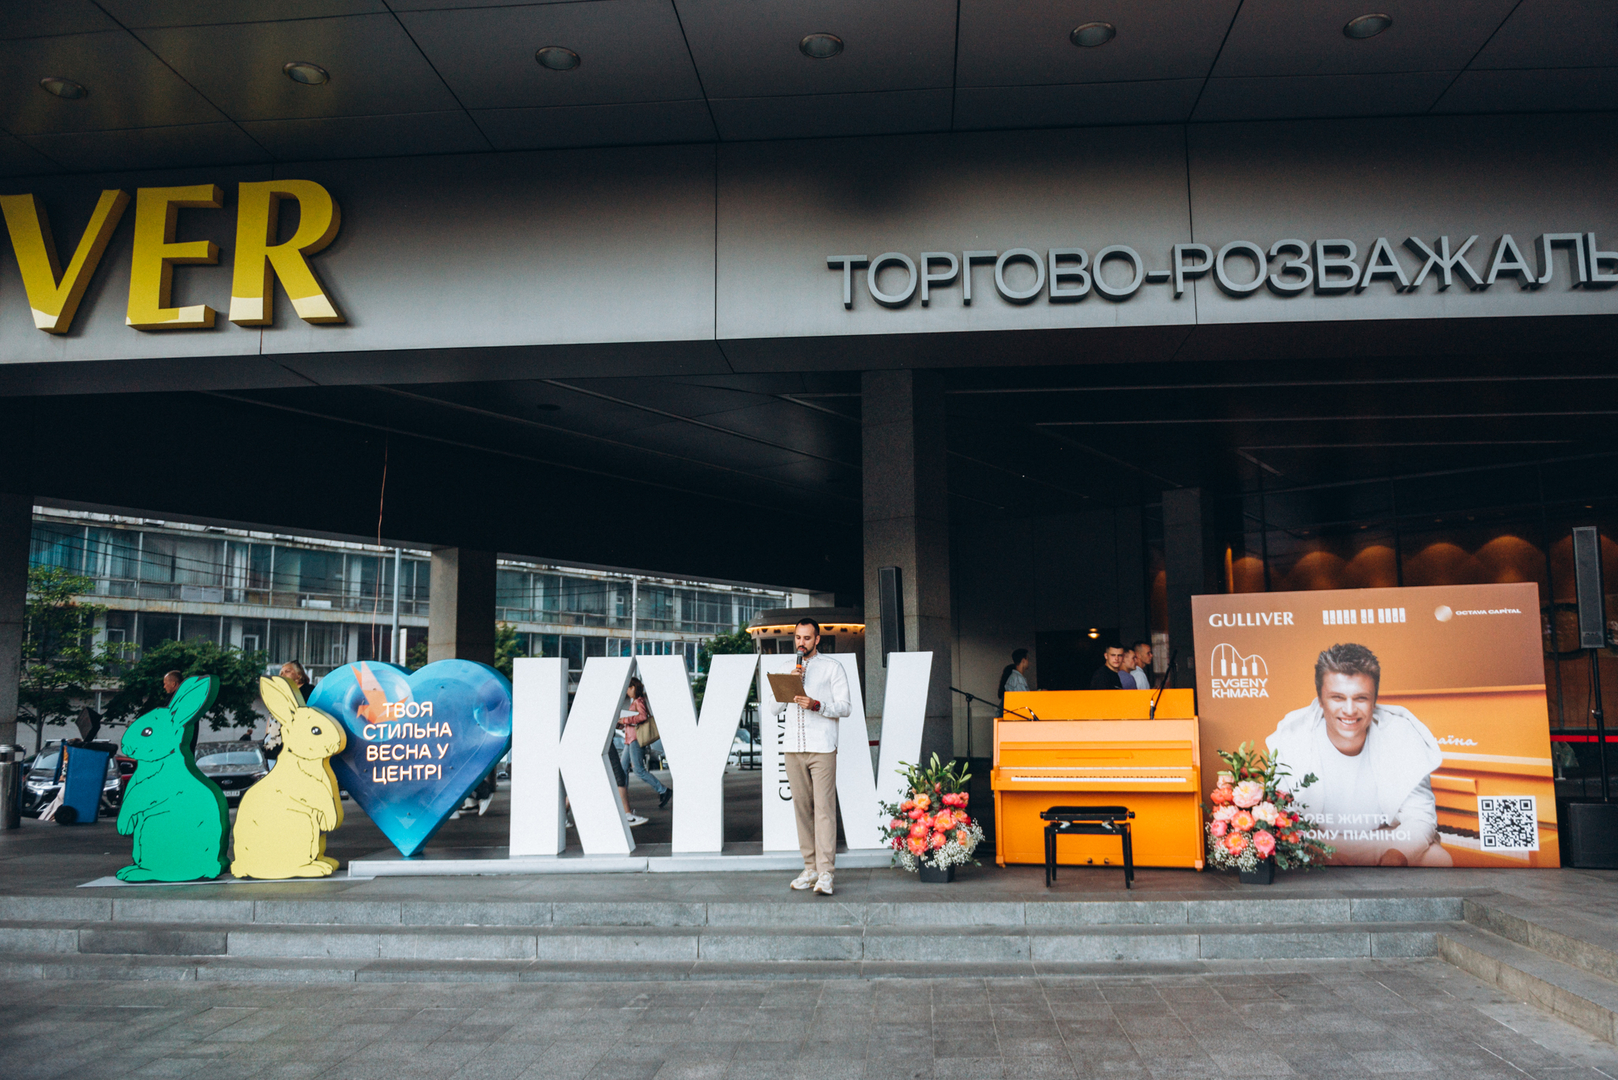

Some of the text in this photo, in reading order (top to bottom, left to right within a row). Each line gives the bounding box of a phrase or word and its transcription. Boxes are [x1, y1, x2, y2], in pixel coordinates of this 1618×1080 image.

[0, 179, 347, 334] VER
[1208, 612, 1295, 628] GULLIVER
[1211, 678, 1268, 688] EVGENY
[1211, 688, 1269, 698] KHMARA
[382, 701, 433, 718] ТВОЯ
[363, 722, 452, 740] СТИЛЬНА
[366, 743, 449, 762] ВЕСНА У
[372, 764, 442, 785] ЦЕНТРІ
[1338, 813, 1389, 824] ЖИТТЯ
[1343, 829, 1411, 841] ПІАНІНО!
